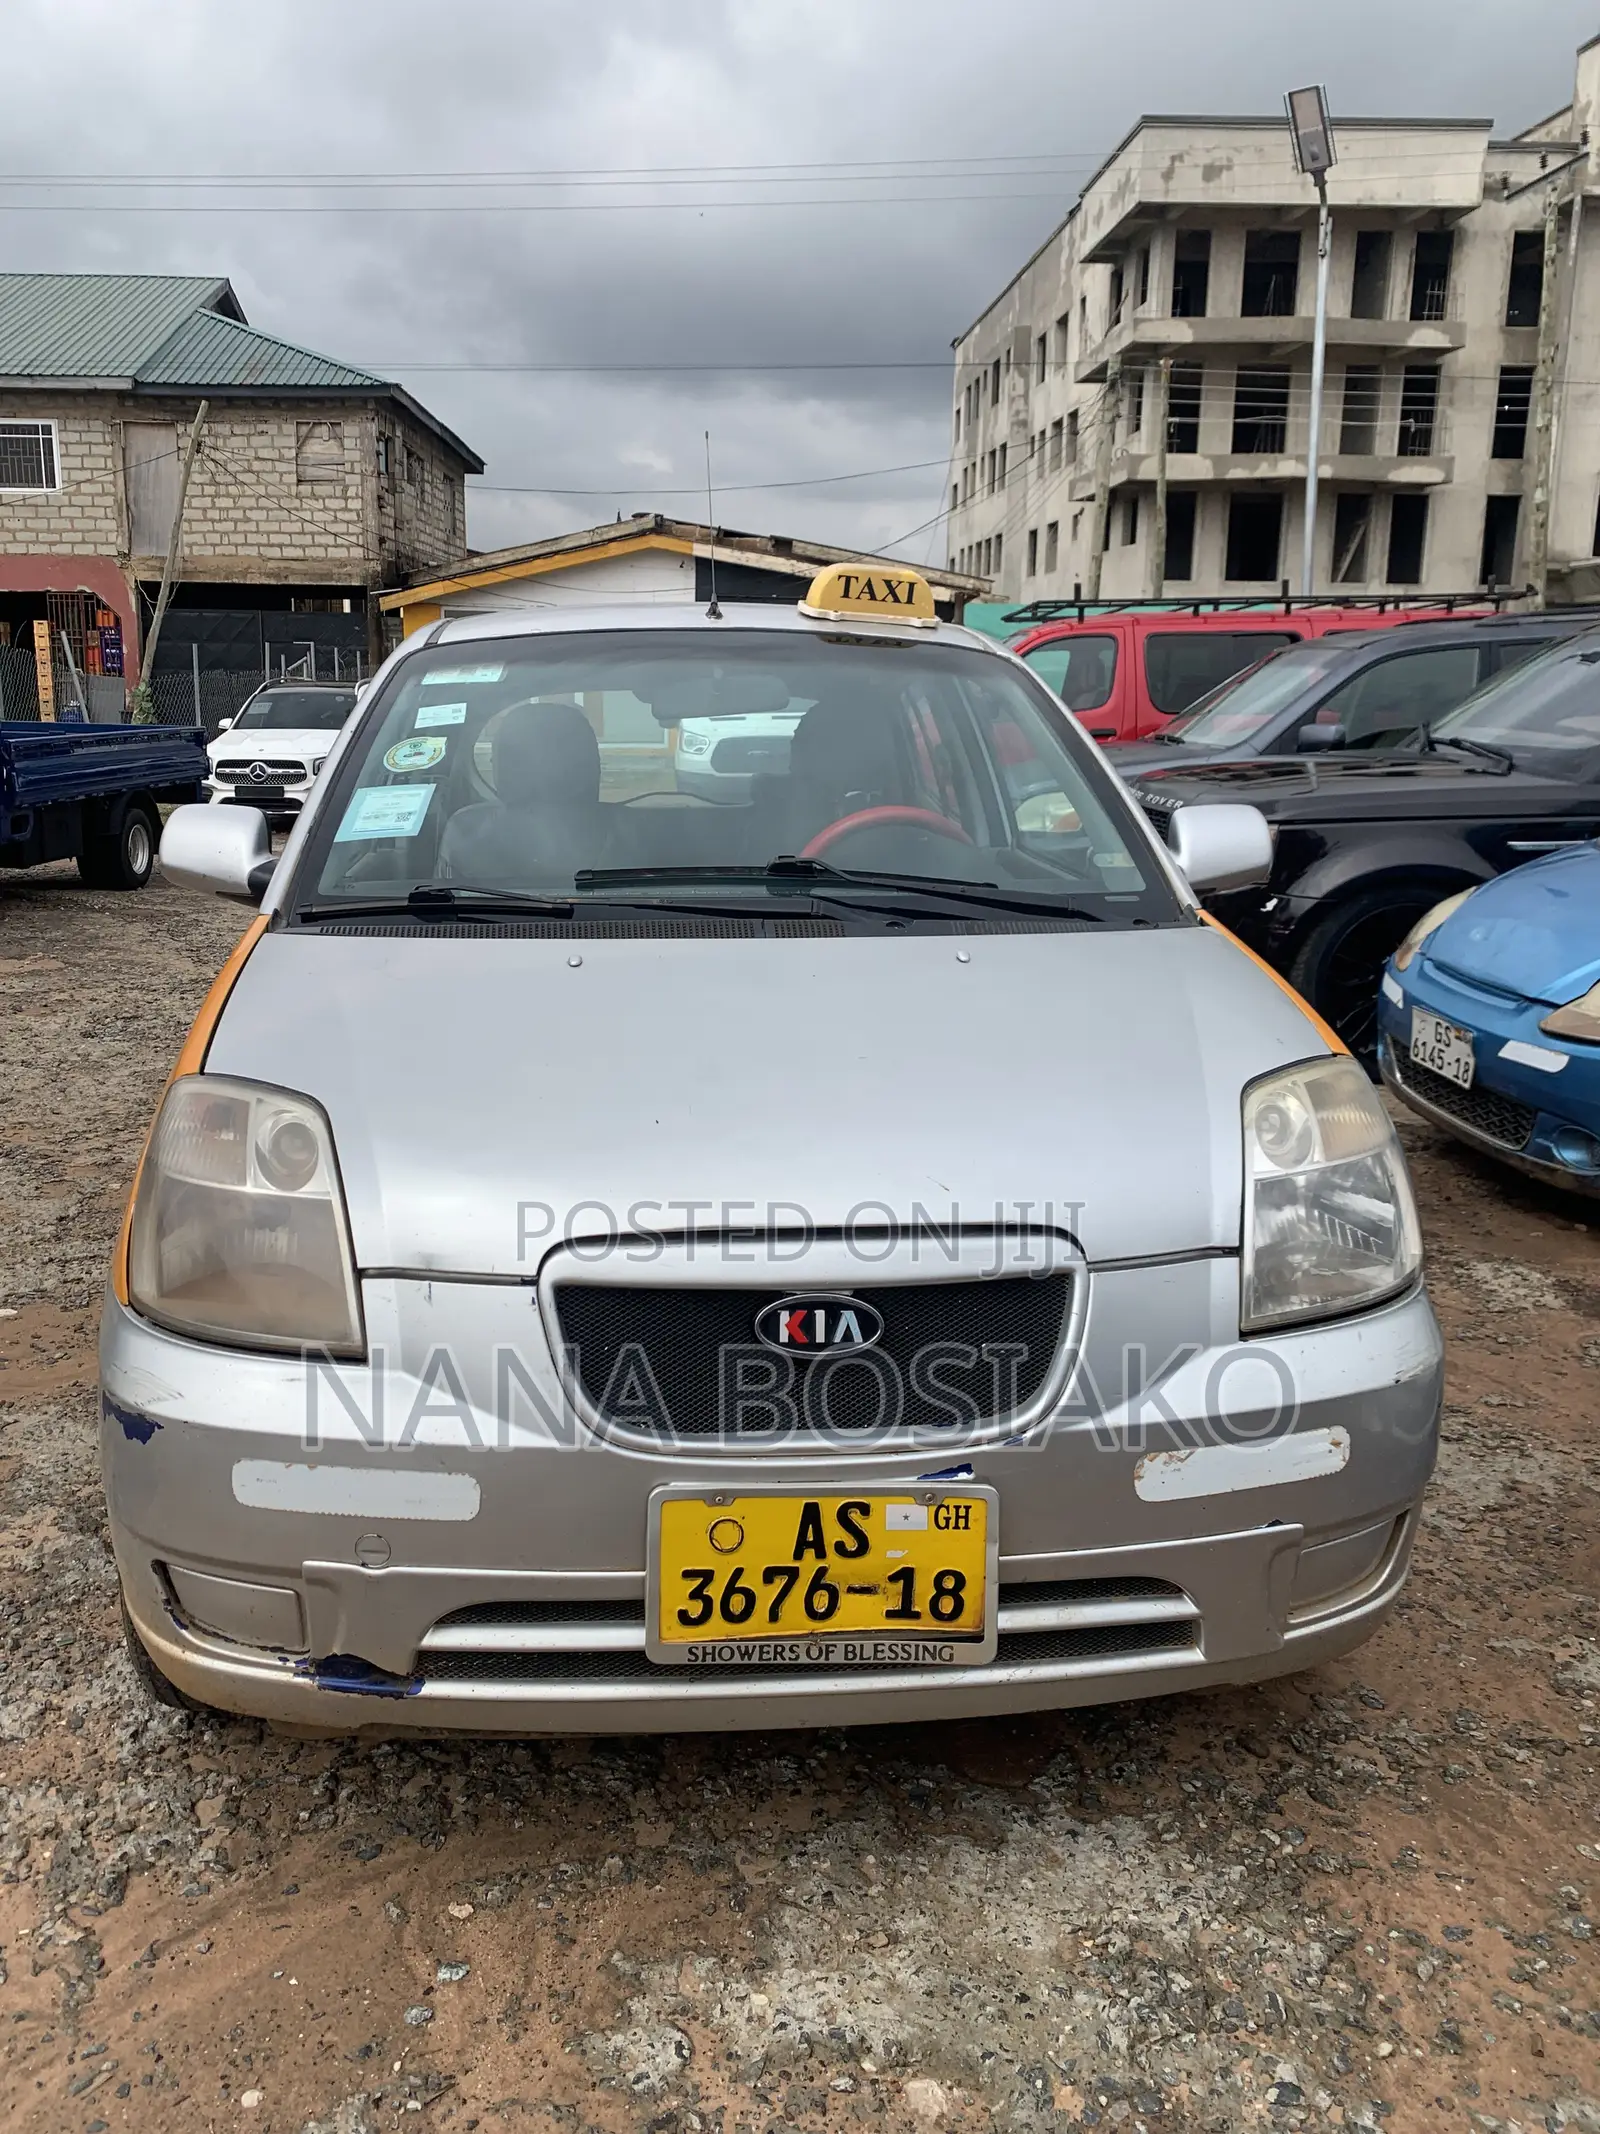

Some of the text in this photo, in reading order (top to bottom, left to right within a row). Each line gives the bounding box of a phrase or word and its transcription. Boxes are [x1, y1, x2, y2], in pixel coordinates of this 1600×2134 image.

[837, 574, 918, 605] TAXI
[1145, 793, 1184, 809] ROVER
[1435, 1021, 1452, 1048] GS
[1412, 1037, 1470, 1084] 6145-18
[778, 1309, 865, 1343] KIA
[793, 1500, 872, 1561] AS
[933, 1504, 973, 1531] GH
[676, 1564, 967, 1628] 3676-18
[687, 1643, 955, 1664] SHOWERS OF BLESSING
